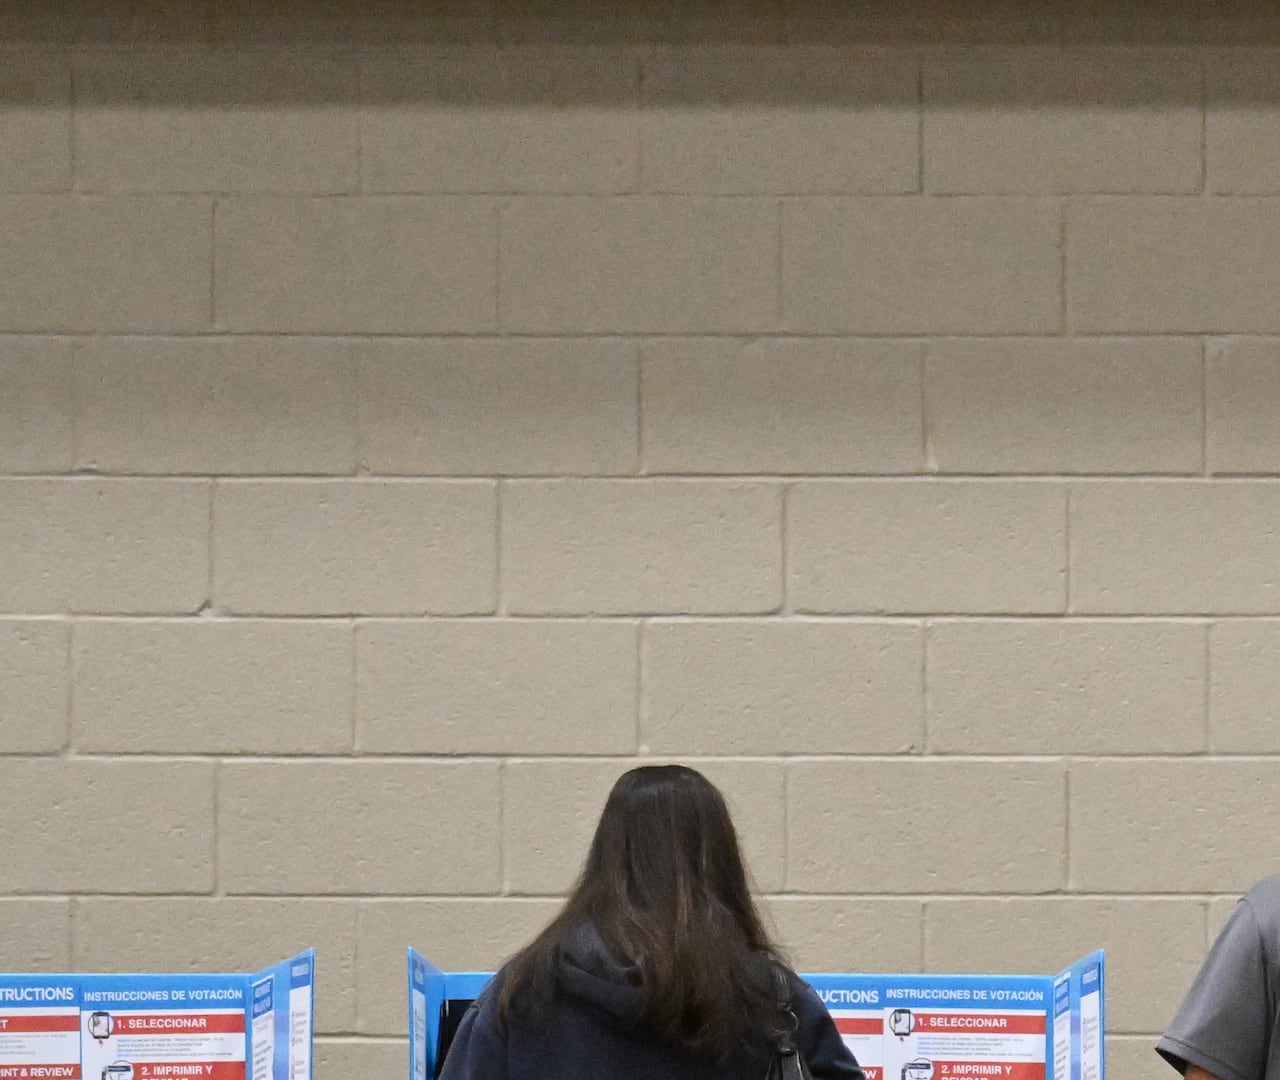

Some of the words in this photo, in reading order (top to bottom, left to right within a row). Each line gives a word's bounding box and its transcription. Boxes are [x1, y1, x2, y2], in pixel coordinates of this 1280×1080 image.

[0, 987, 74, 1001] TRUCTIONS
[84, 990, 168, 1001] INSTRUCCIONES
[171, 990, 185, 1000] DE
[188, 987, 242, 1000] VOTACIÓN
[886, 989, 970, 1000] INSTRUCCIONES
[973, 989, 987, 1000] DE
[990, 988, 1043, 1001] VOTACIÓN
[117, 1020, 126, 1029] 1.
[128, 1018, 207, 1029] SELECCIONAR
[918, 1018, 927, 1027] 1.
[929, 1017, 1007, 1028] SELECCIONAR
[30, 1067, 74, 1077] REVIEW
[141, 1066, 151, 1075] 2.
[153, 1065, 203, 1075] IMPRIMIR
[205, 1065, 213, 1074] Y
[941, 1065, 950, 1074] 2.
[953, 1065, 1002, 1075] IMPRIMIR
[1005, 1065, 1012, 1075] Y
